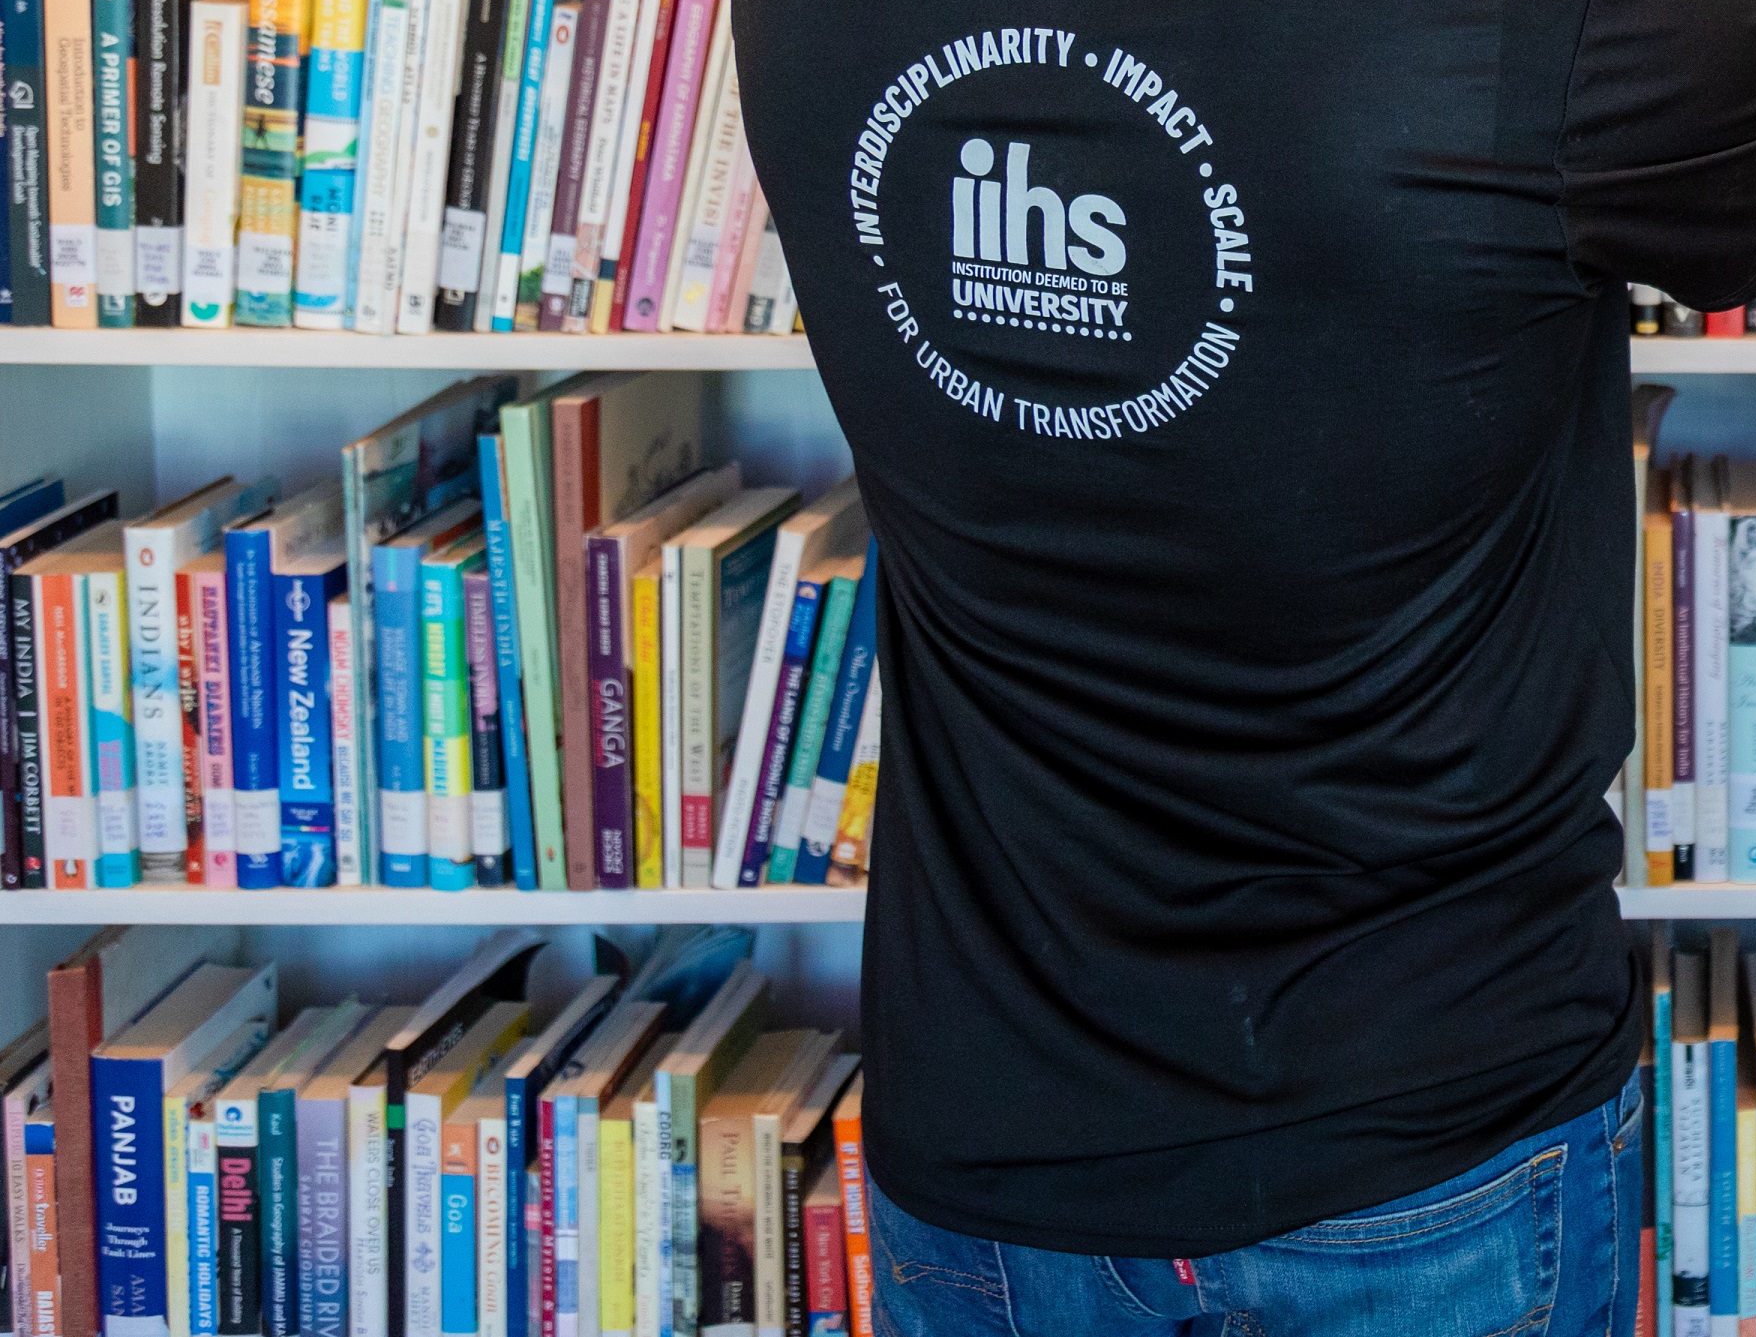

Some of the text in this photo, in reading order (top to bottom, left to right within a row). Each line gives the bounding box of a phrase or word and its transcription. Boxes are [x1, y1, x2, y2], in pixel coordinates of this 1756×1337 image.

[102, 33, 122, 206] A PRIMER OF GIS
[851, 27, 1252, 292] INTERDISCIPLINARY IMPACT SCALE
[953, 138, 1127, 276] iihs
[952, 279, 1128, 326] UNIVERSITY
[953, 262, 1128, 296] INSTITUTION DEEMED TO BE
[878, 282, 1240, 439] FOR URBAN TRANSFORMATION
[15, 599, 33, 698] MY INDIA
[138, 584, 164, 720] INDIANS
[288, 630, 317, 790] New Zealand
[599, 679, 625, 767] GANGA
[21, 732, 40, 834] JIM CORBETT
[111, 1096, 137, 1204] PANJAB
[221, 1158, 252, 1221] Delhi
[196, 1186, 212, 1327] ROMANTIC HOLIDAYS
[446, 1194, 467, 1233] Goa
